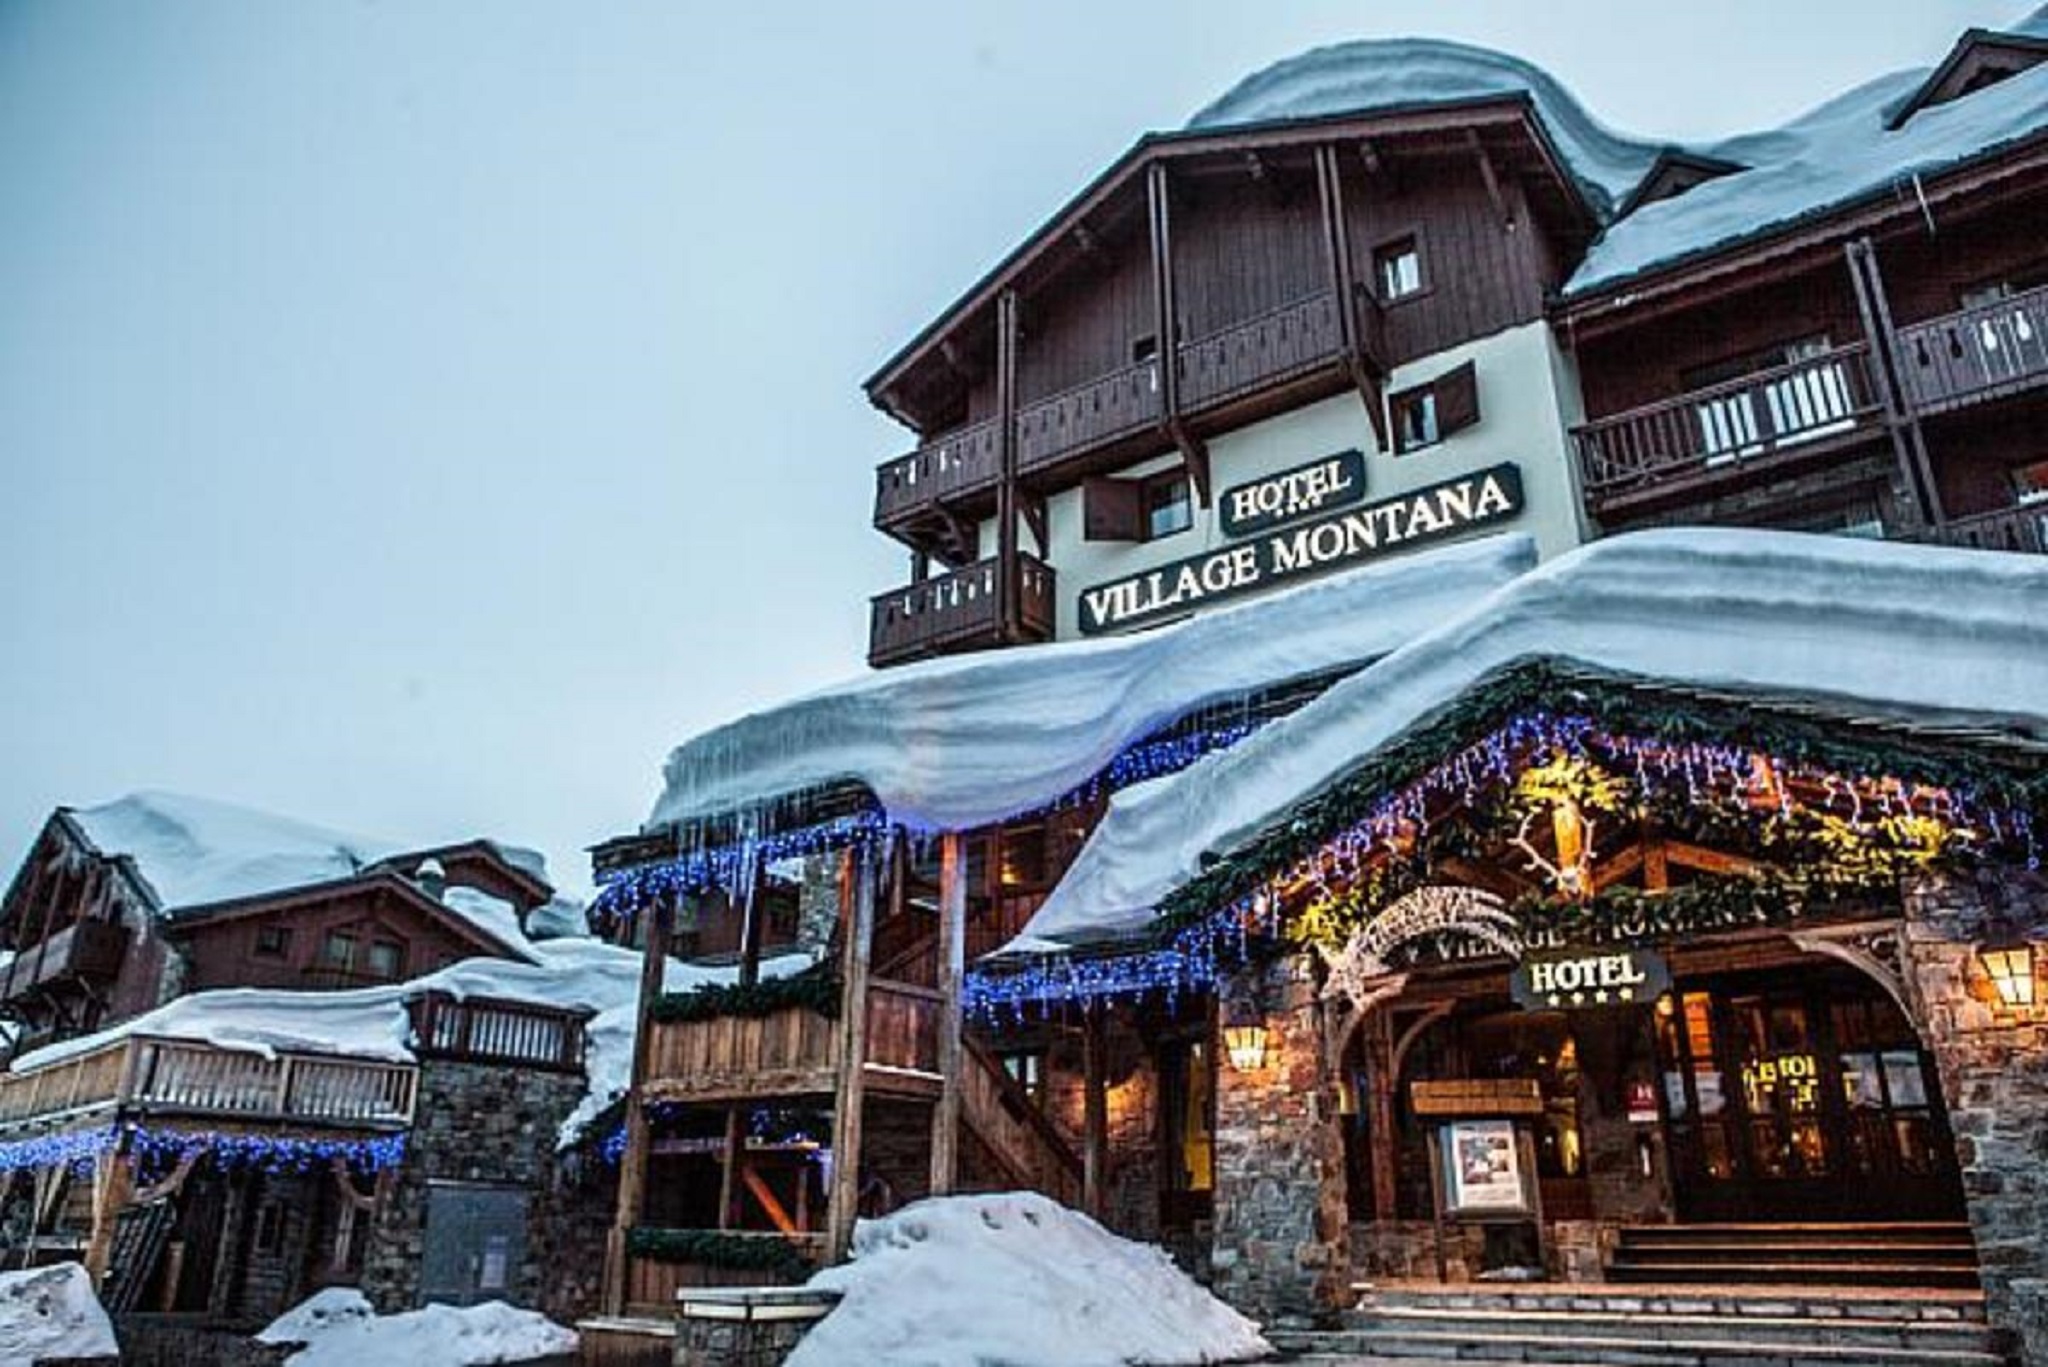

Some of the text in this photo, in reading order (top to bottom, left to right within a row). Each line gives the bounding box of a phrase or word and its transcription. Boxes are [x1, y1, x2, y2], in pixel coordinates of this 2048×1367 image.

[1231, 461, 1352, 522] HOTEL
[1085, 474, 1511, 625] VILLAGE MONTANA
[1530, 953, 1645, 993] HOTEL
